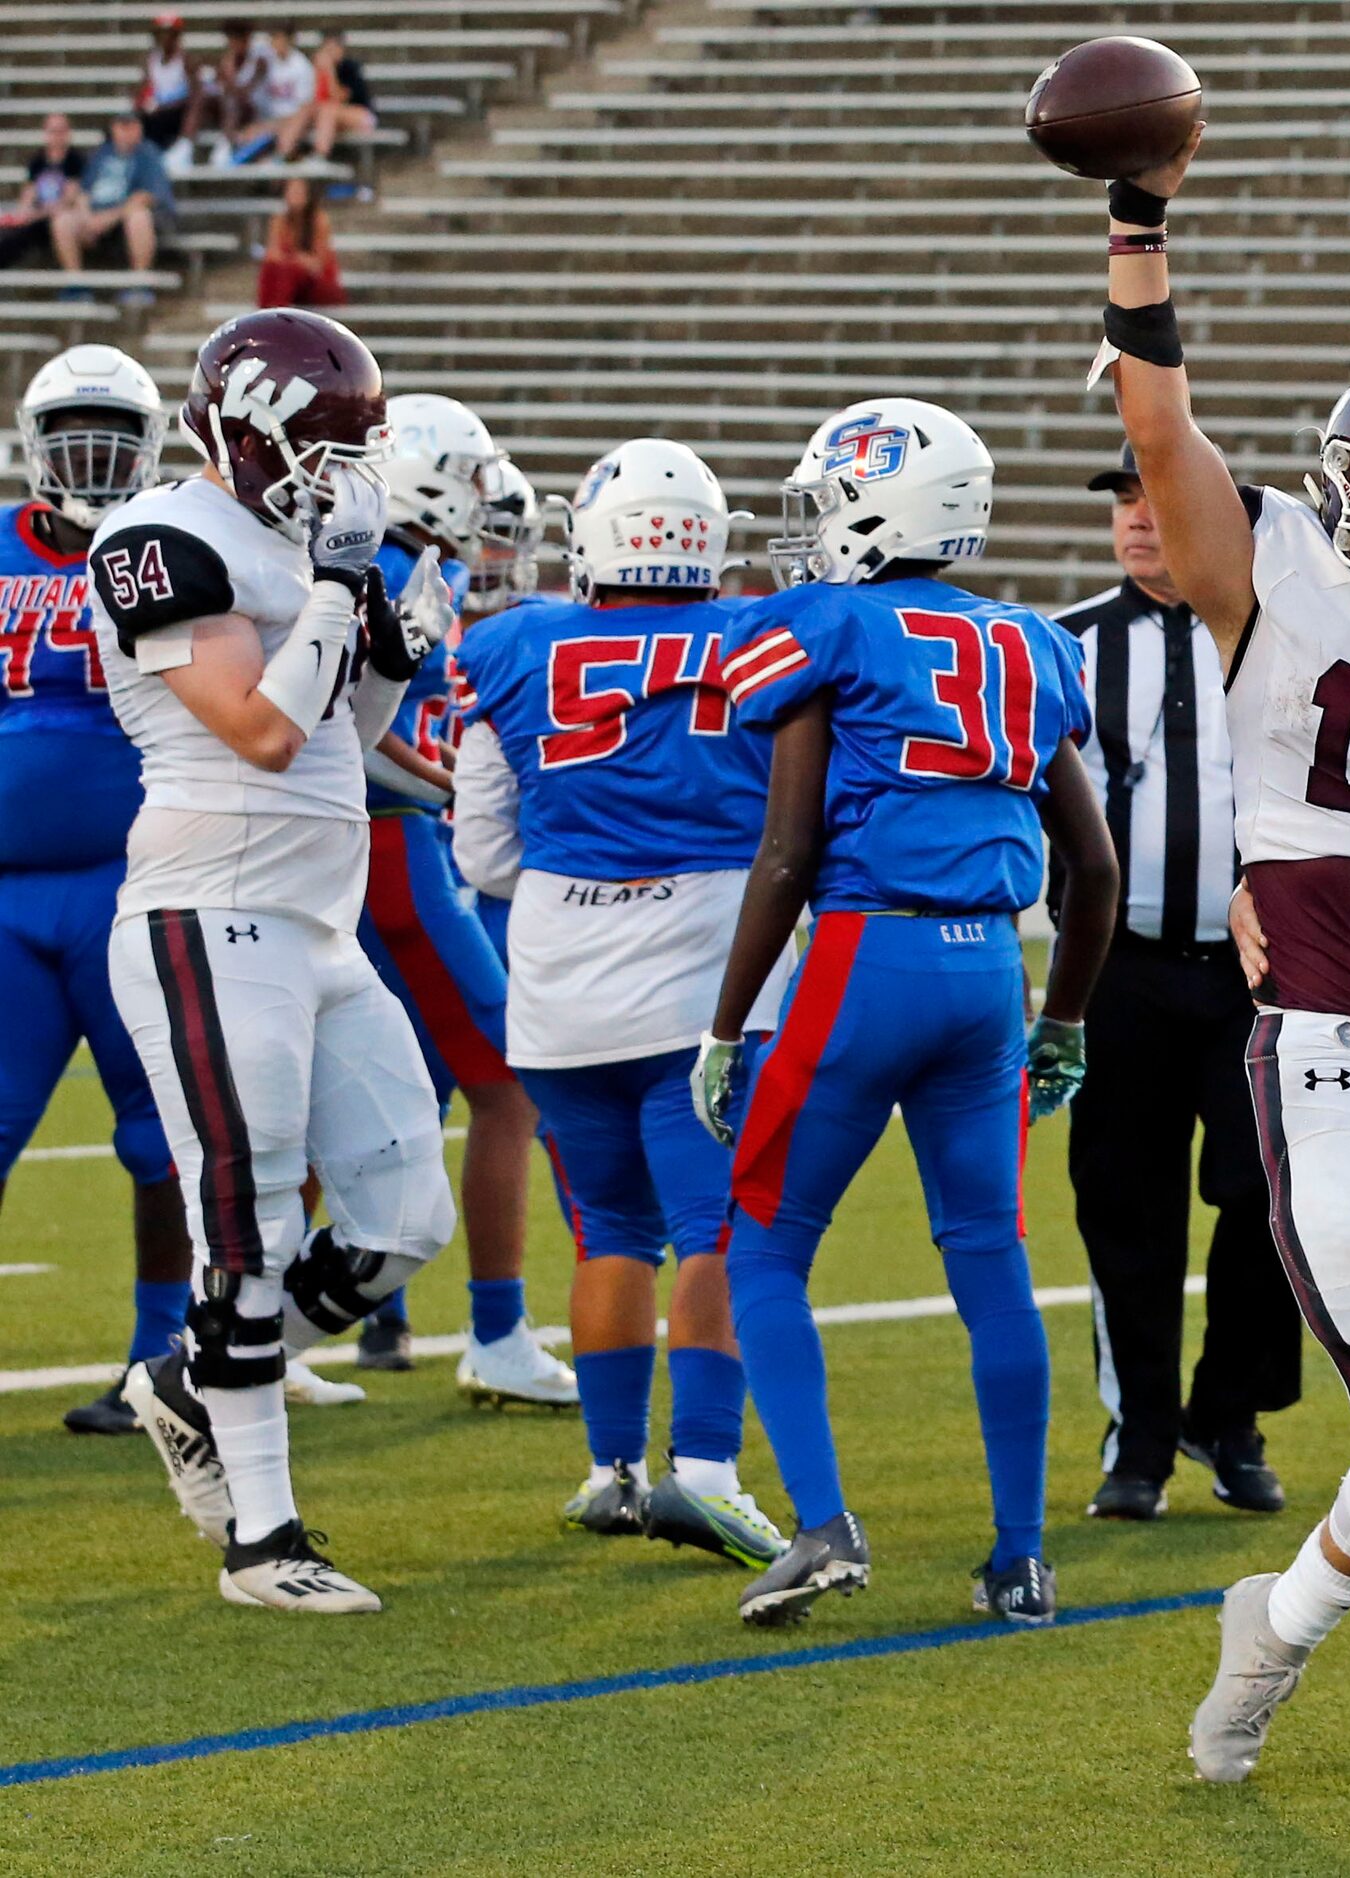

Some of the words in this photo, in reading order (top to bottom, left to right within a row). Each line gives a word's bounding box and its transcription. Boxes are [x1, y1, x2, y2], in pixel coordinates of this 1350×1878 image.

[102, 539, 174, 611] 54
[617, 565, 712, 584] TITANS
[536, 631, 732, 771] 54
[894, 608, 1040, 792] 31
